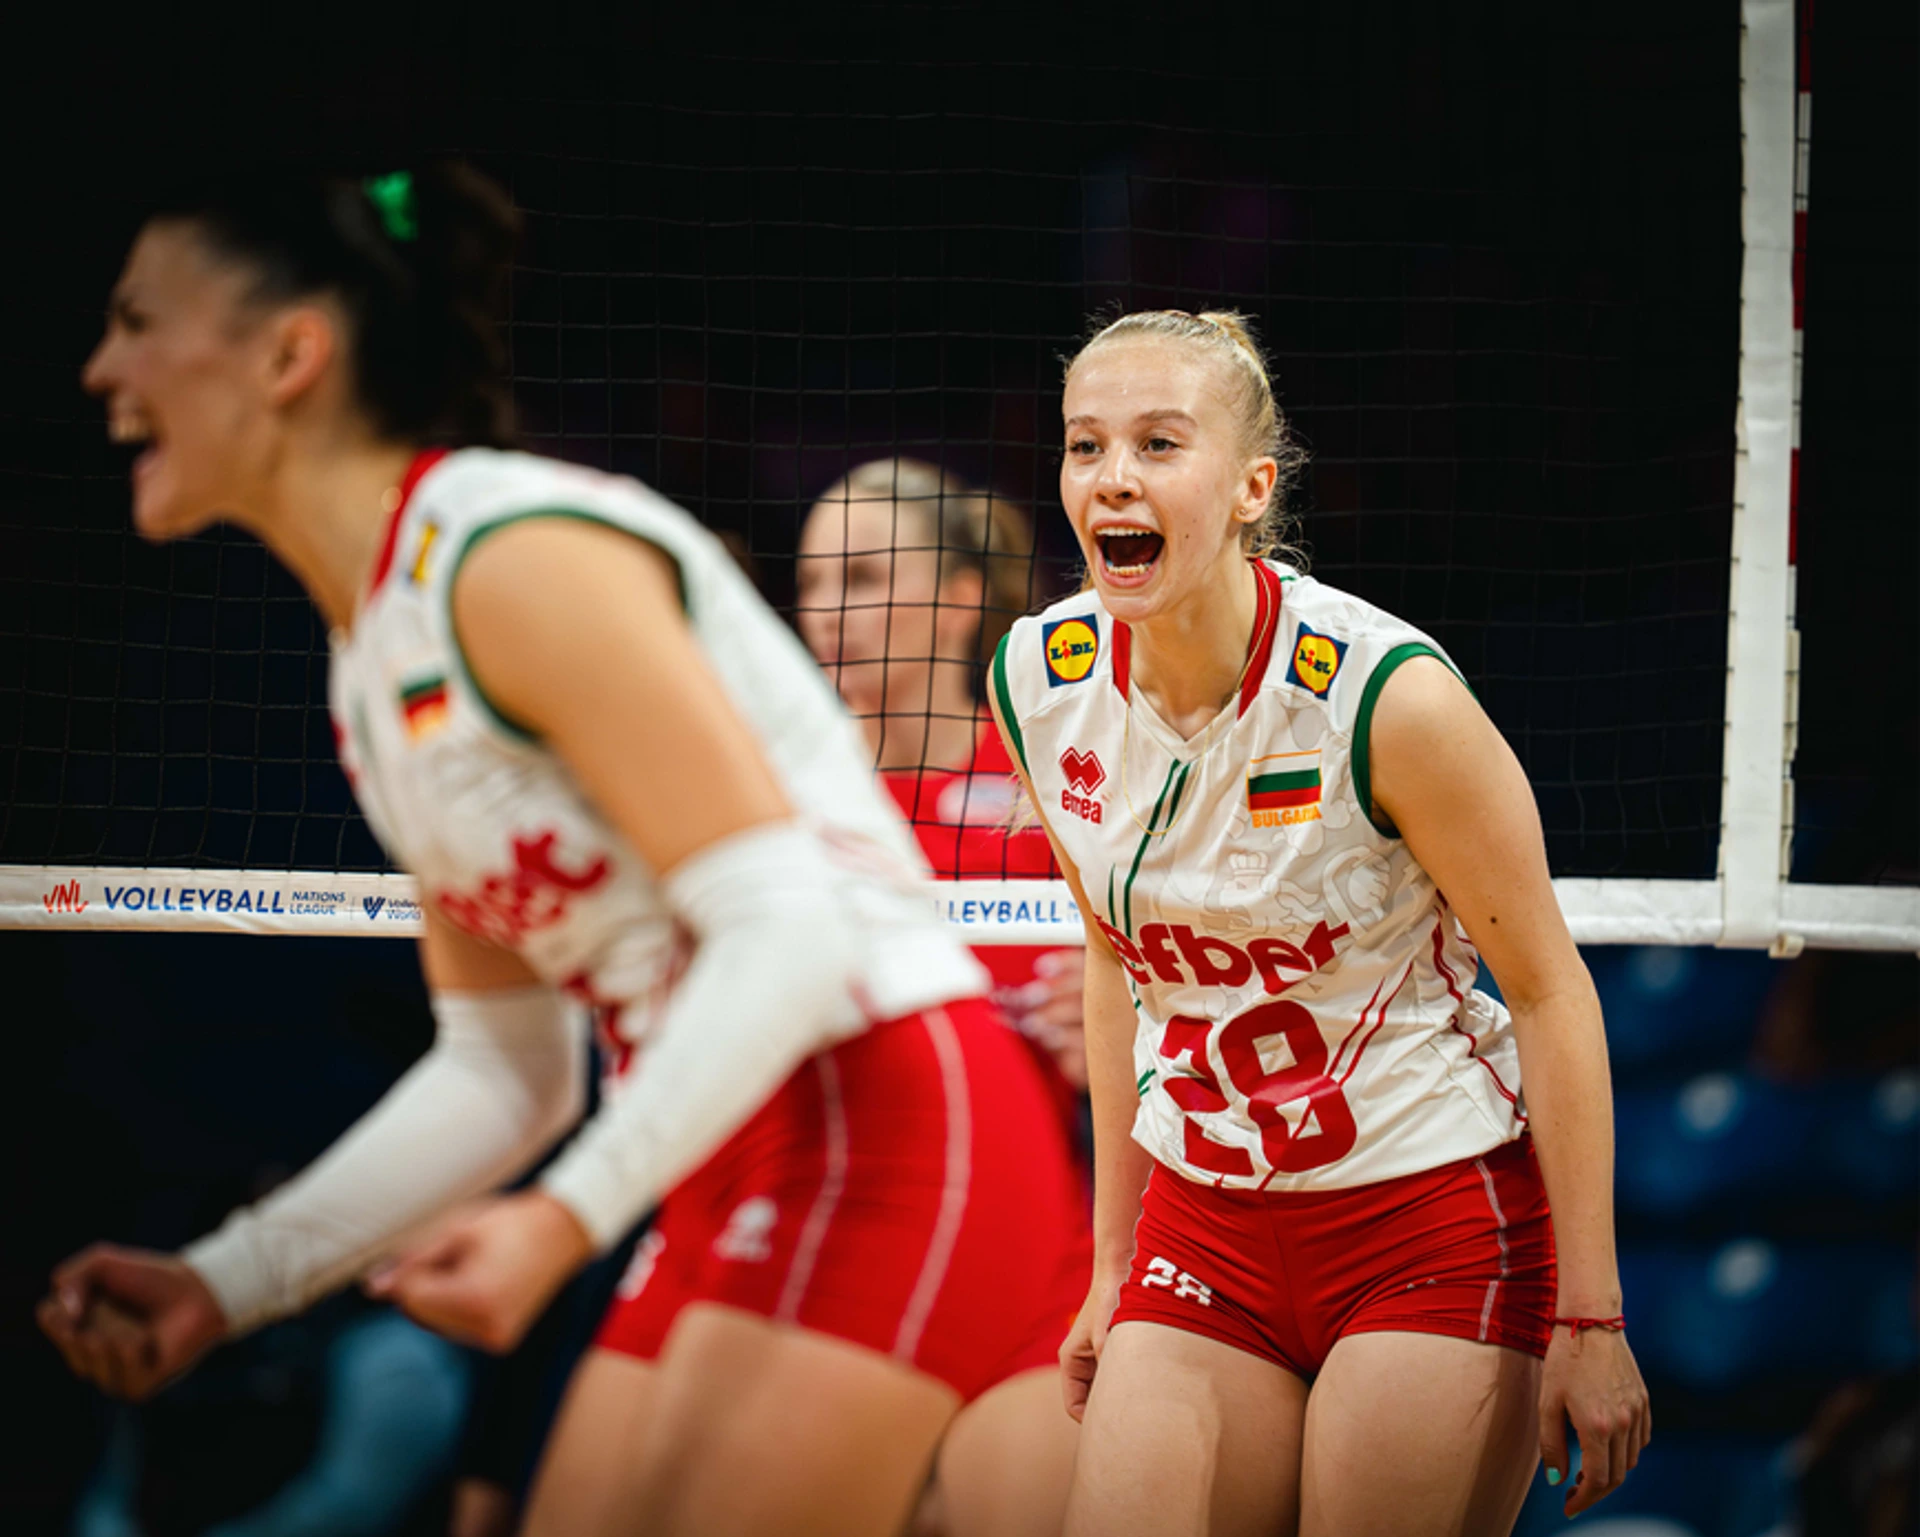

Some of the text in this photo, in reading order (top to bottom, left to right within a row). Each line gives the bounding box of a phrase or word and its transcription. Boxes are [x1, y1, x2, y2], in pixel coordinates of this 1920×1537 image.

[104, 886, 285, 914] VOLLEYBALL
[292, 891, 346, 902] NATIONS
[289, 903, 336, 915] LEAGUE
[934, 900, 1062, 923] LEYBALL
[1159, 1000, 1357, 1176] 28
